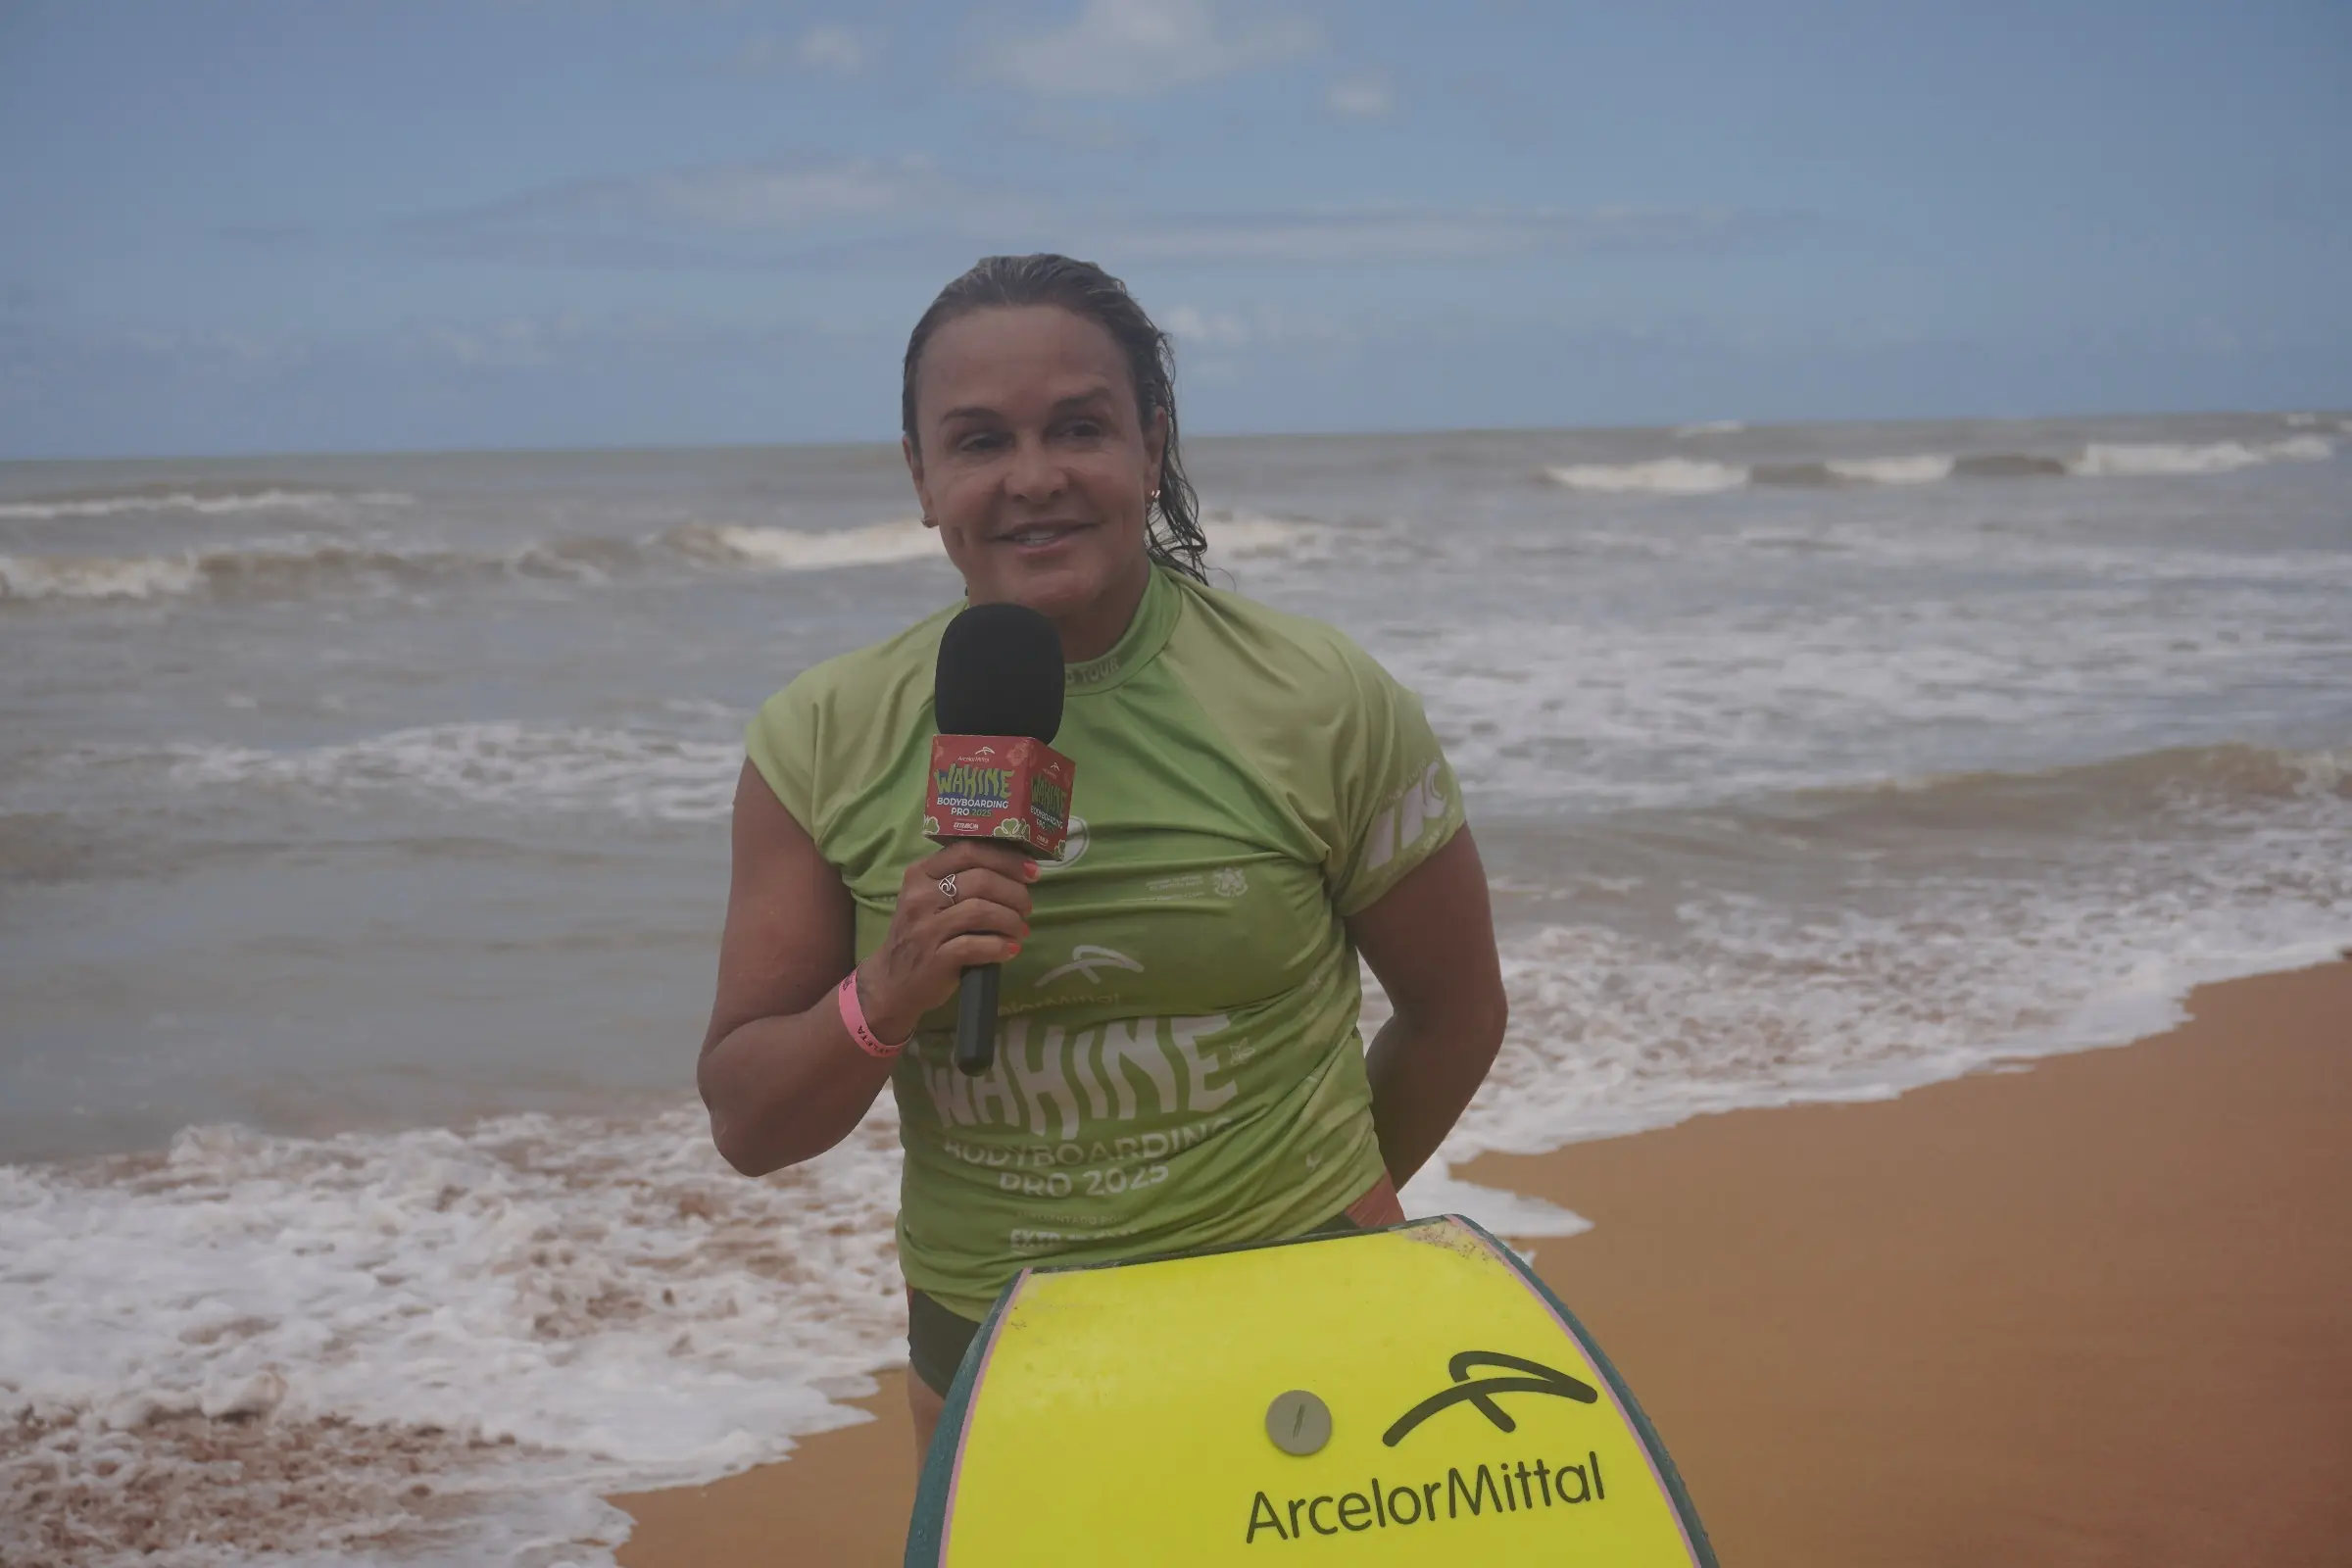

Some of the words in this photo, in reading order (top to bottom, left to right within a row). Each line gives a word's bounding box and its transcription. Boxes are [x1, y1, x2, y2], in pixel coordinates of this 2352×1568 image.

[1080, 657, 1120, 682] TOUR
[934, 763, 1015, 799] WAHINE
[936, 797, 1008, 809] BODYBOARDING
[951, 808, 970, 816] PRO
[971, 808, 992, 817] 2025
[909, 1013, 1238, 1141] WAHINE
[1000, 1171, 1072, 1197] PRO
[1082, 1163, 1169, 1197] 2025
[1246, 1450, 1605, 1544] ArcelorMittal
